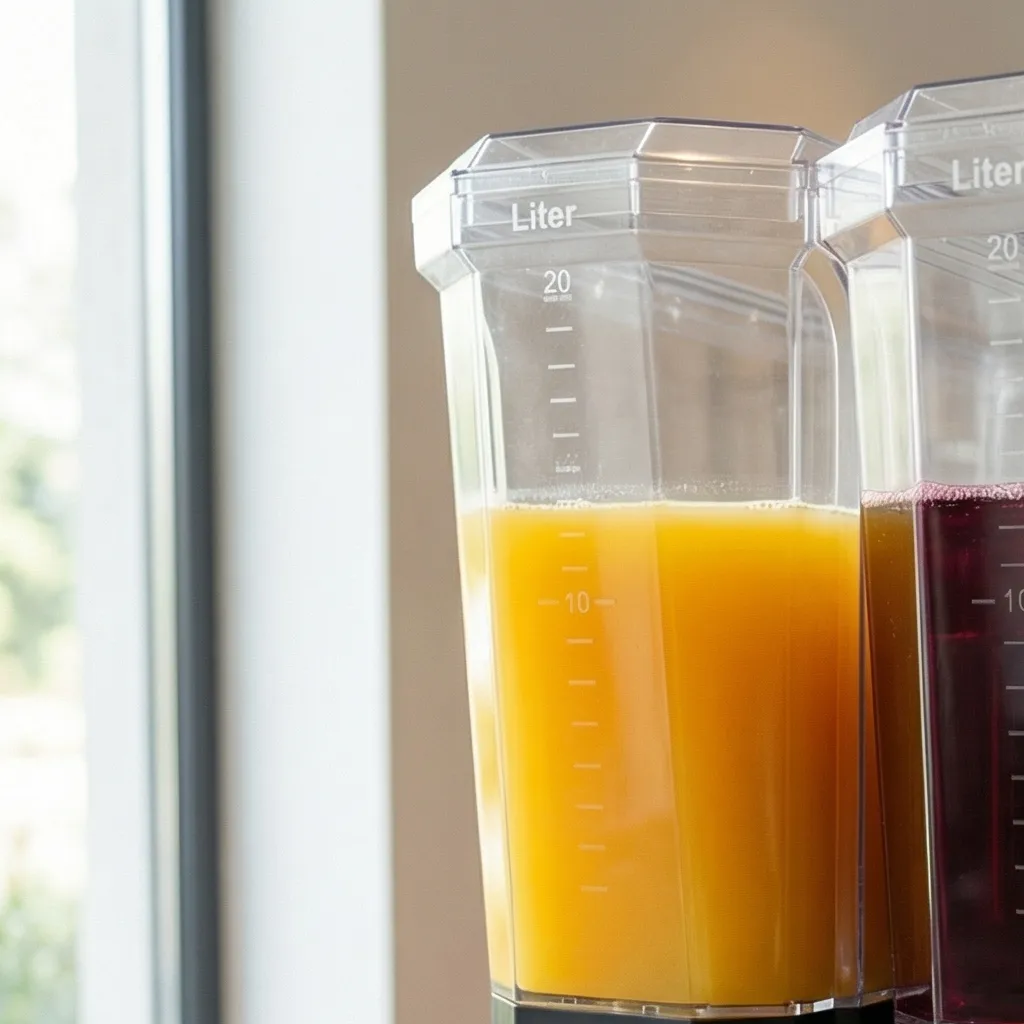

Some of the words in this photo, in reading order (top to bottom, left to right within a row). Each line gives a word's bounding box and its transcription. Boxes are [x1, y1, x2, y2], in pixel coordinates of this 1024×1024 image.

[511, 200, 577, 232] Liter
[986, 233, 1018, 261] 20
[543, 269, 571, 294] 20
[565, 590, 590, 614] 10
